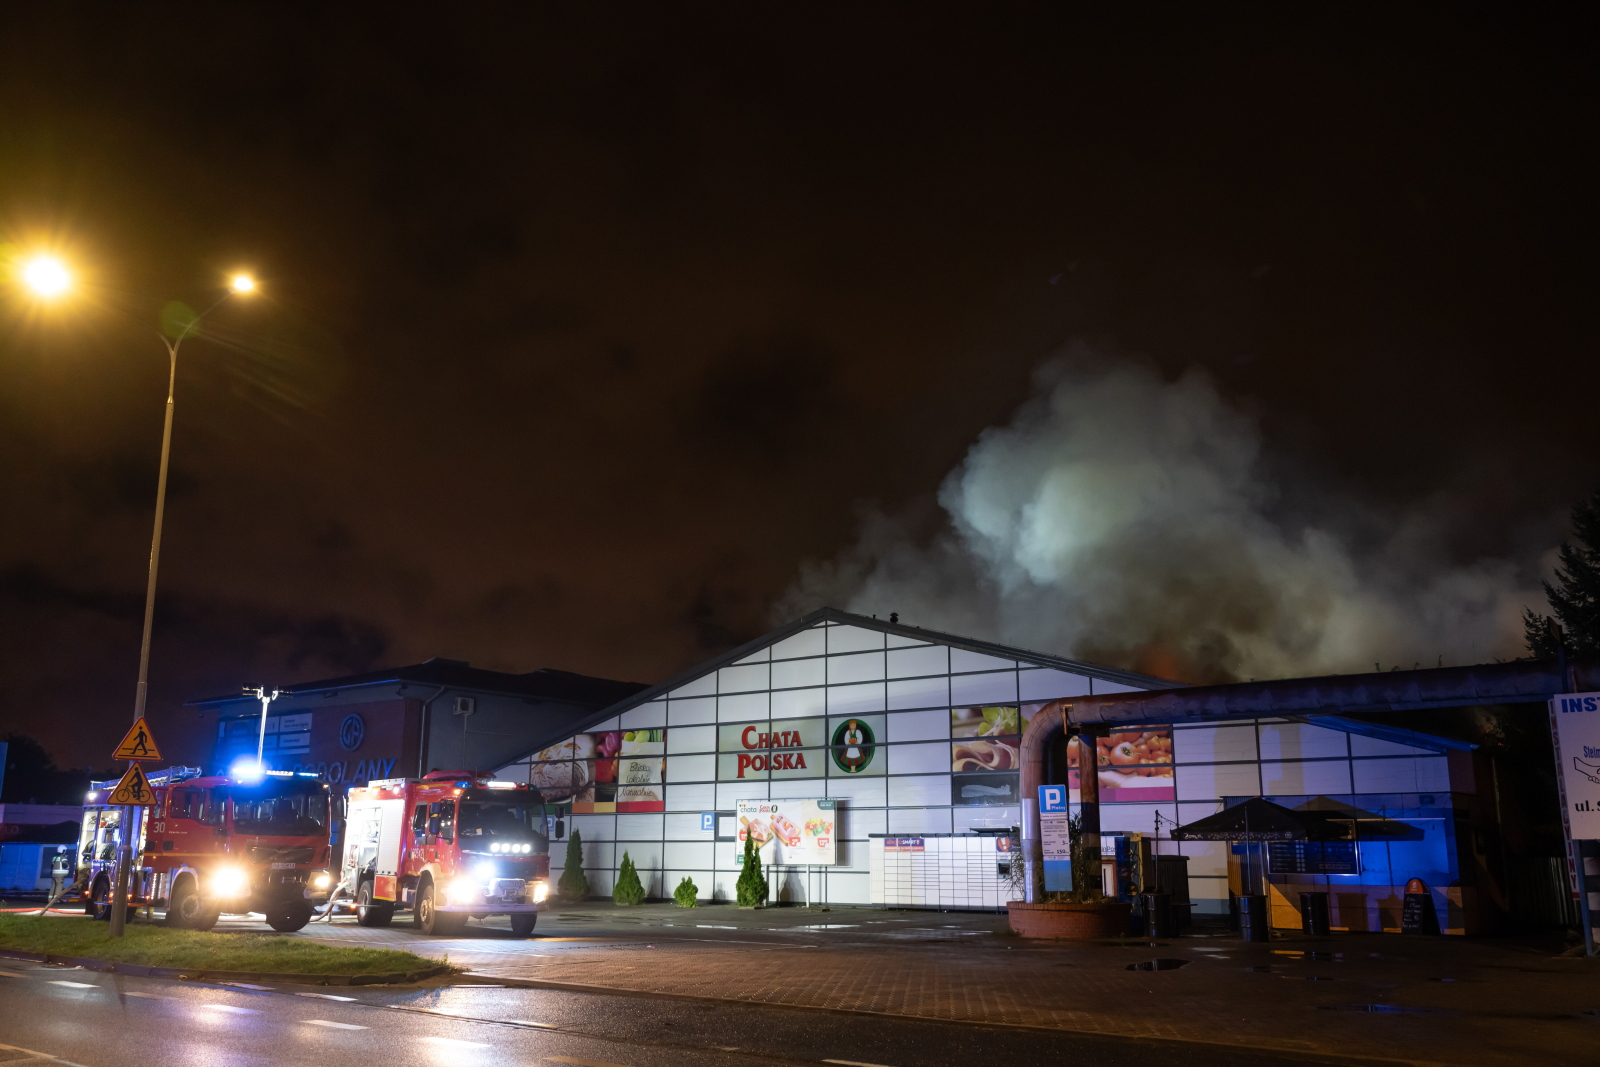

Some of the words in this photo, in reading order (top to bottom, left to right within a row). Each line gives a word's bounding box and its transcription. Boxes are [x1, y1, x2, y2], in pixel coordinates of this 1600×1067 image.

[1561, 697, 1600, 713] INS
[1044, 788, 1061, 810] P
[1574, 800, 1595, 812] ul.
[153, 822, 166, 833] 30
[704, 814, 712, 829] P
